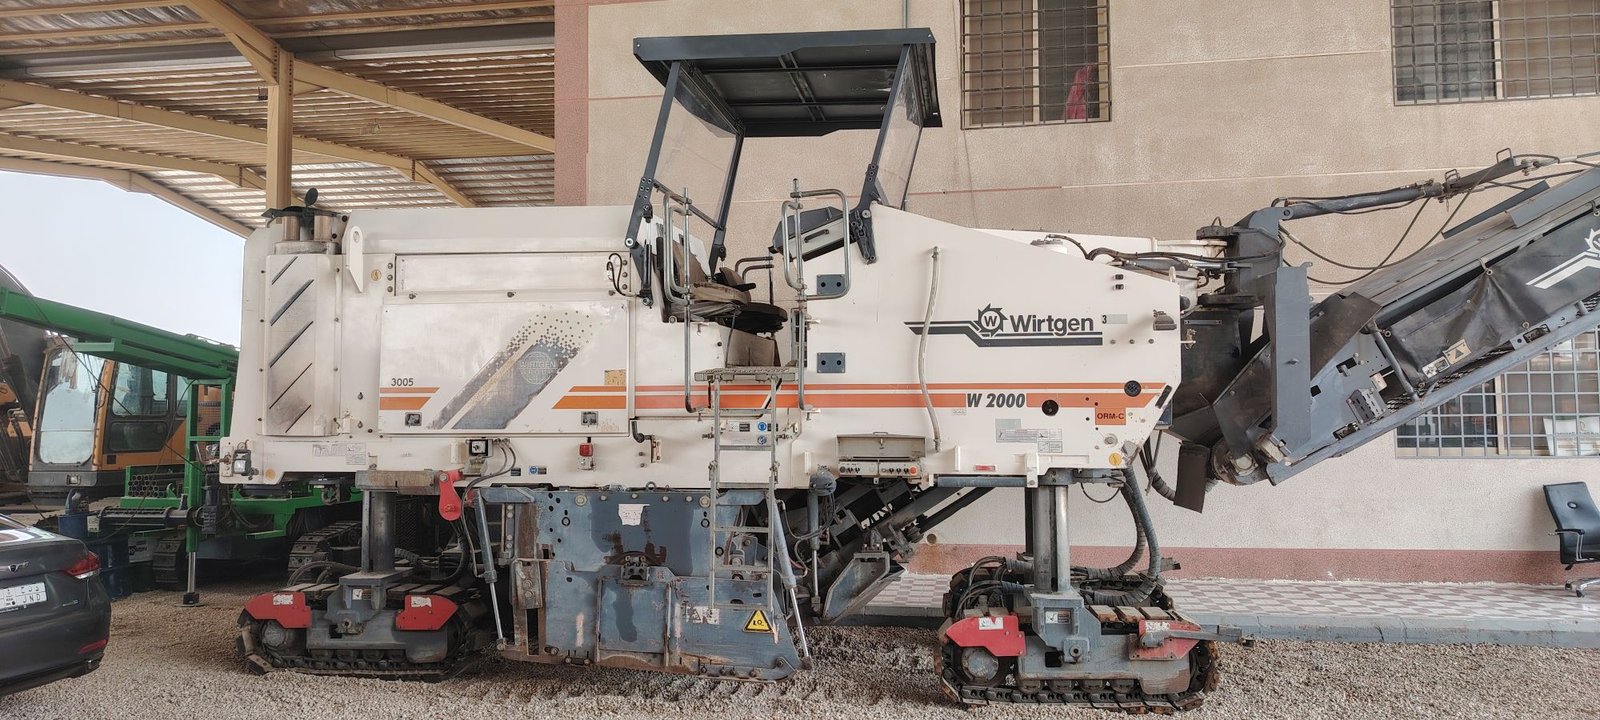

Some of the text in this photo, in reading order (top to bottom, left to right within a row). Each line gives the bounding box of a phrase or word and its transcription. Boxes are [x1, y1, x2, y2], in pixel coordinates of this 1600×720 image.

[1009, 314, 1094, 336] Wirtgen
[391, 377, 414, 387] 3005
[967, 393, 1026, 408] W 2000
[1096, 412, 1125, 420] ORM-C
